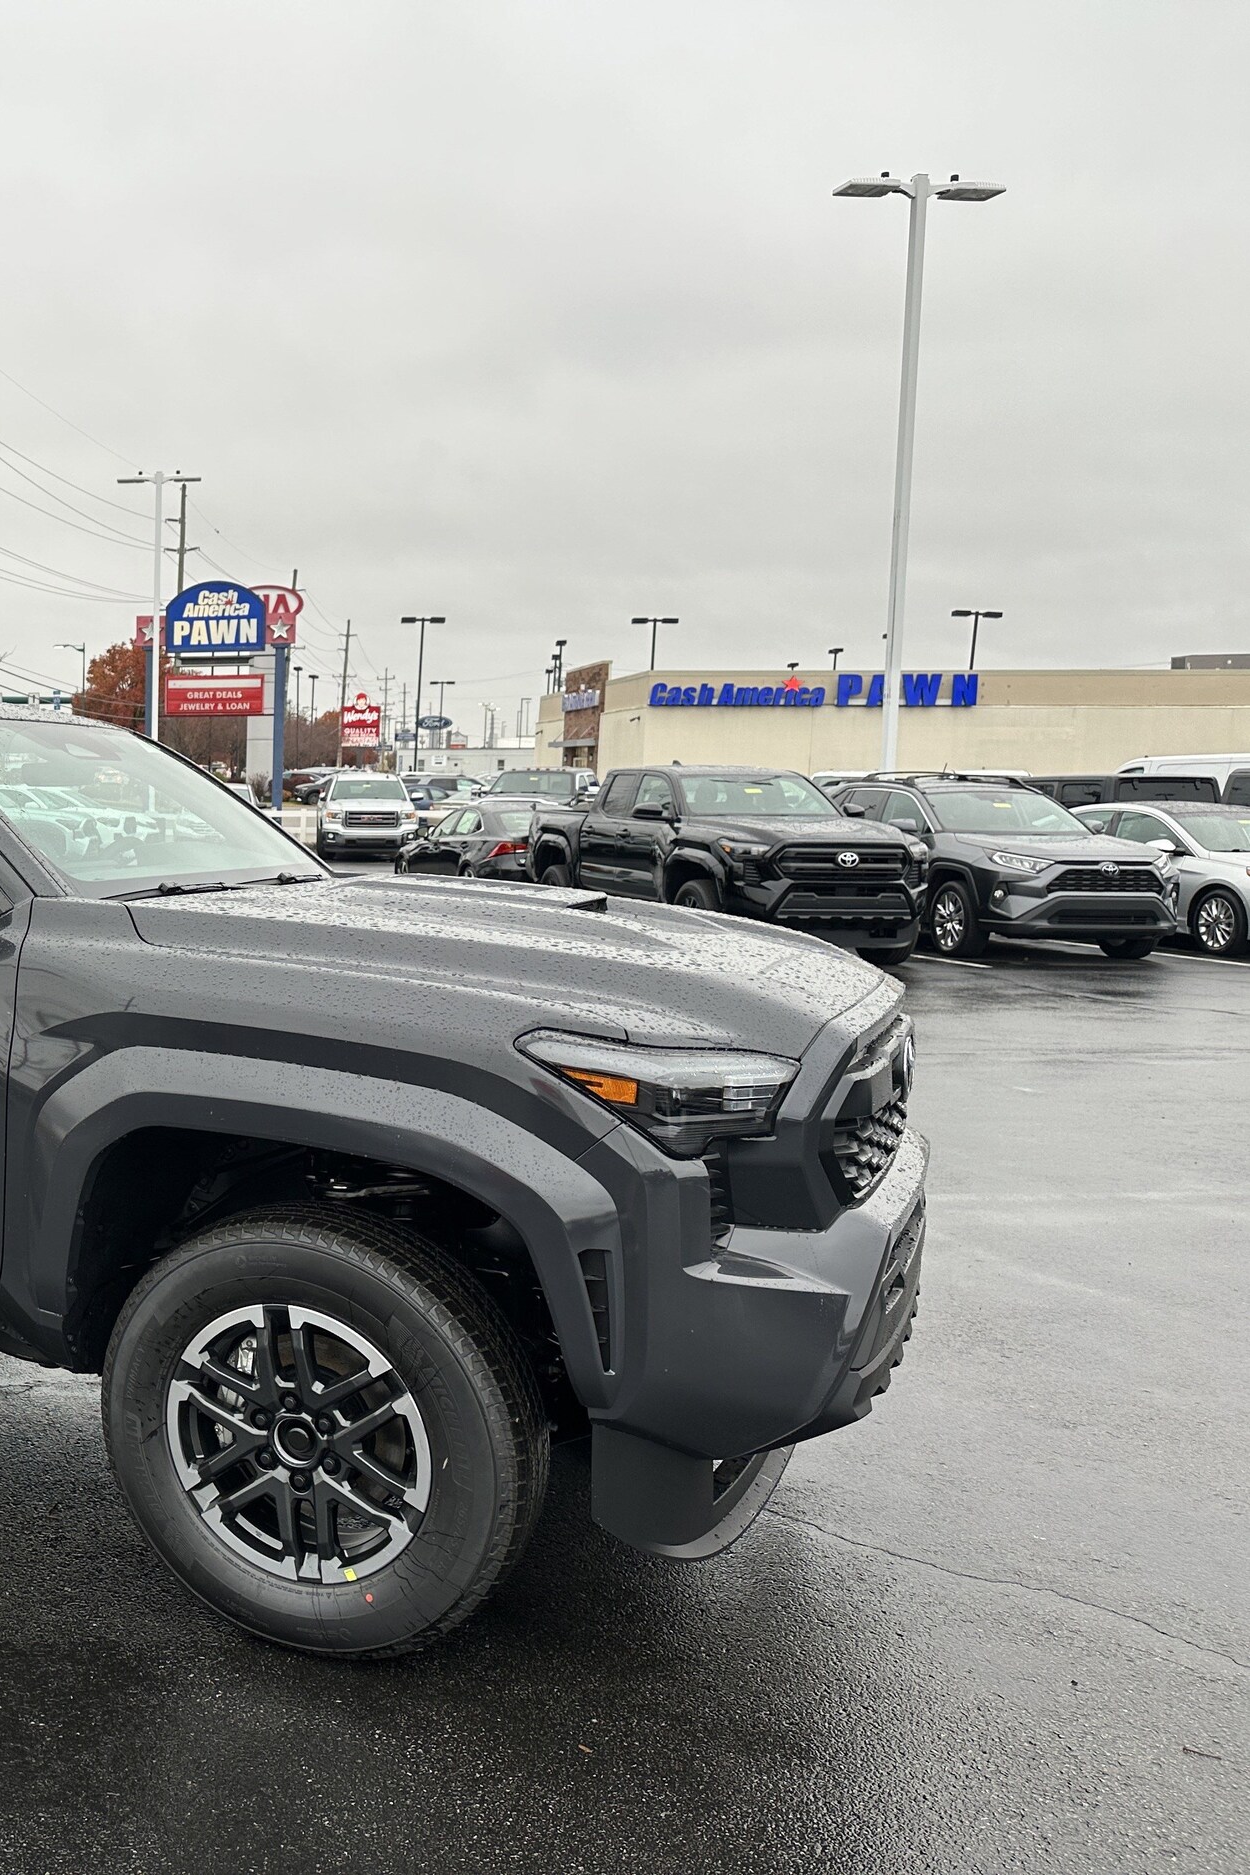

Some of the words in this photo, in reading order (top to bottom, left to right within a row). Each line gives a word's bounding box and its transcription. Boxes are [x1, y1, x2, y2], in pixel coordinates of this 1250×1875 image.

[198, 589, 239, 606] Cash
[182, 602, 250, 618] America
[173, 618, 258, 646] PAWN
[187, 691, 214, 699] GREAT
[215, 691, 243, 699] DEALS
[650, 683, 715, 706] Cash
[717, 683, 826, 707] America
[179, 703, 216, 711] JEWELRY
[226, 702, 250, 710] LOAN
[344, 711, 379, 724] Wendy's
[344, 727, 377, 735] QUALITY
